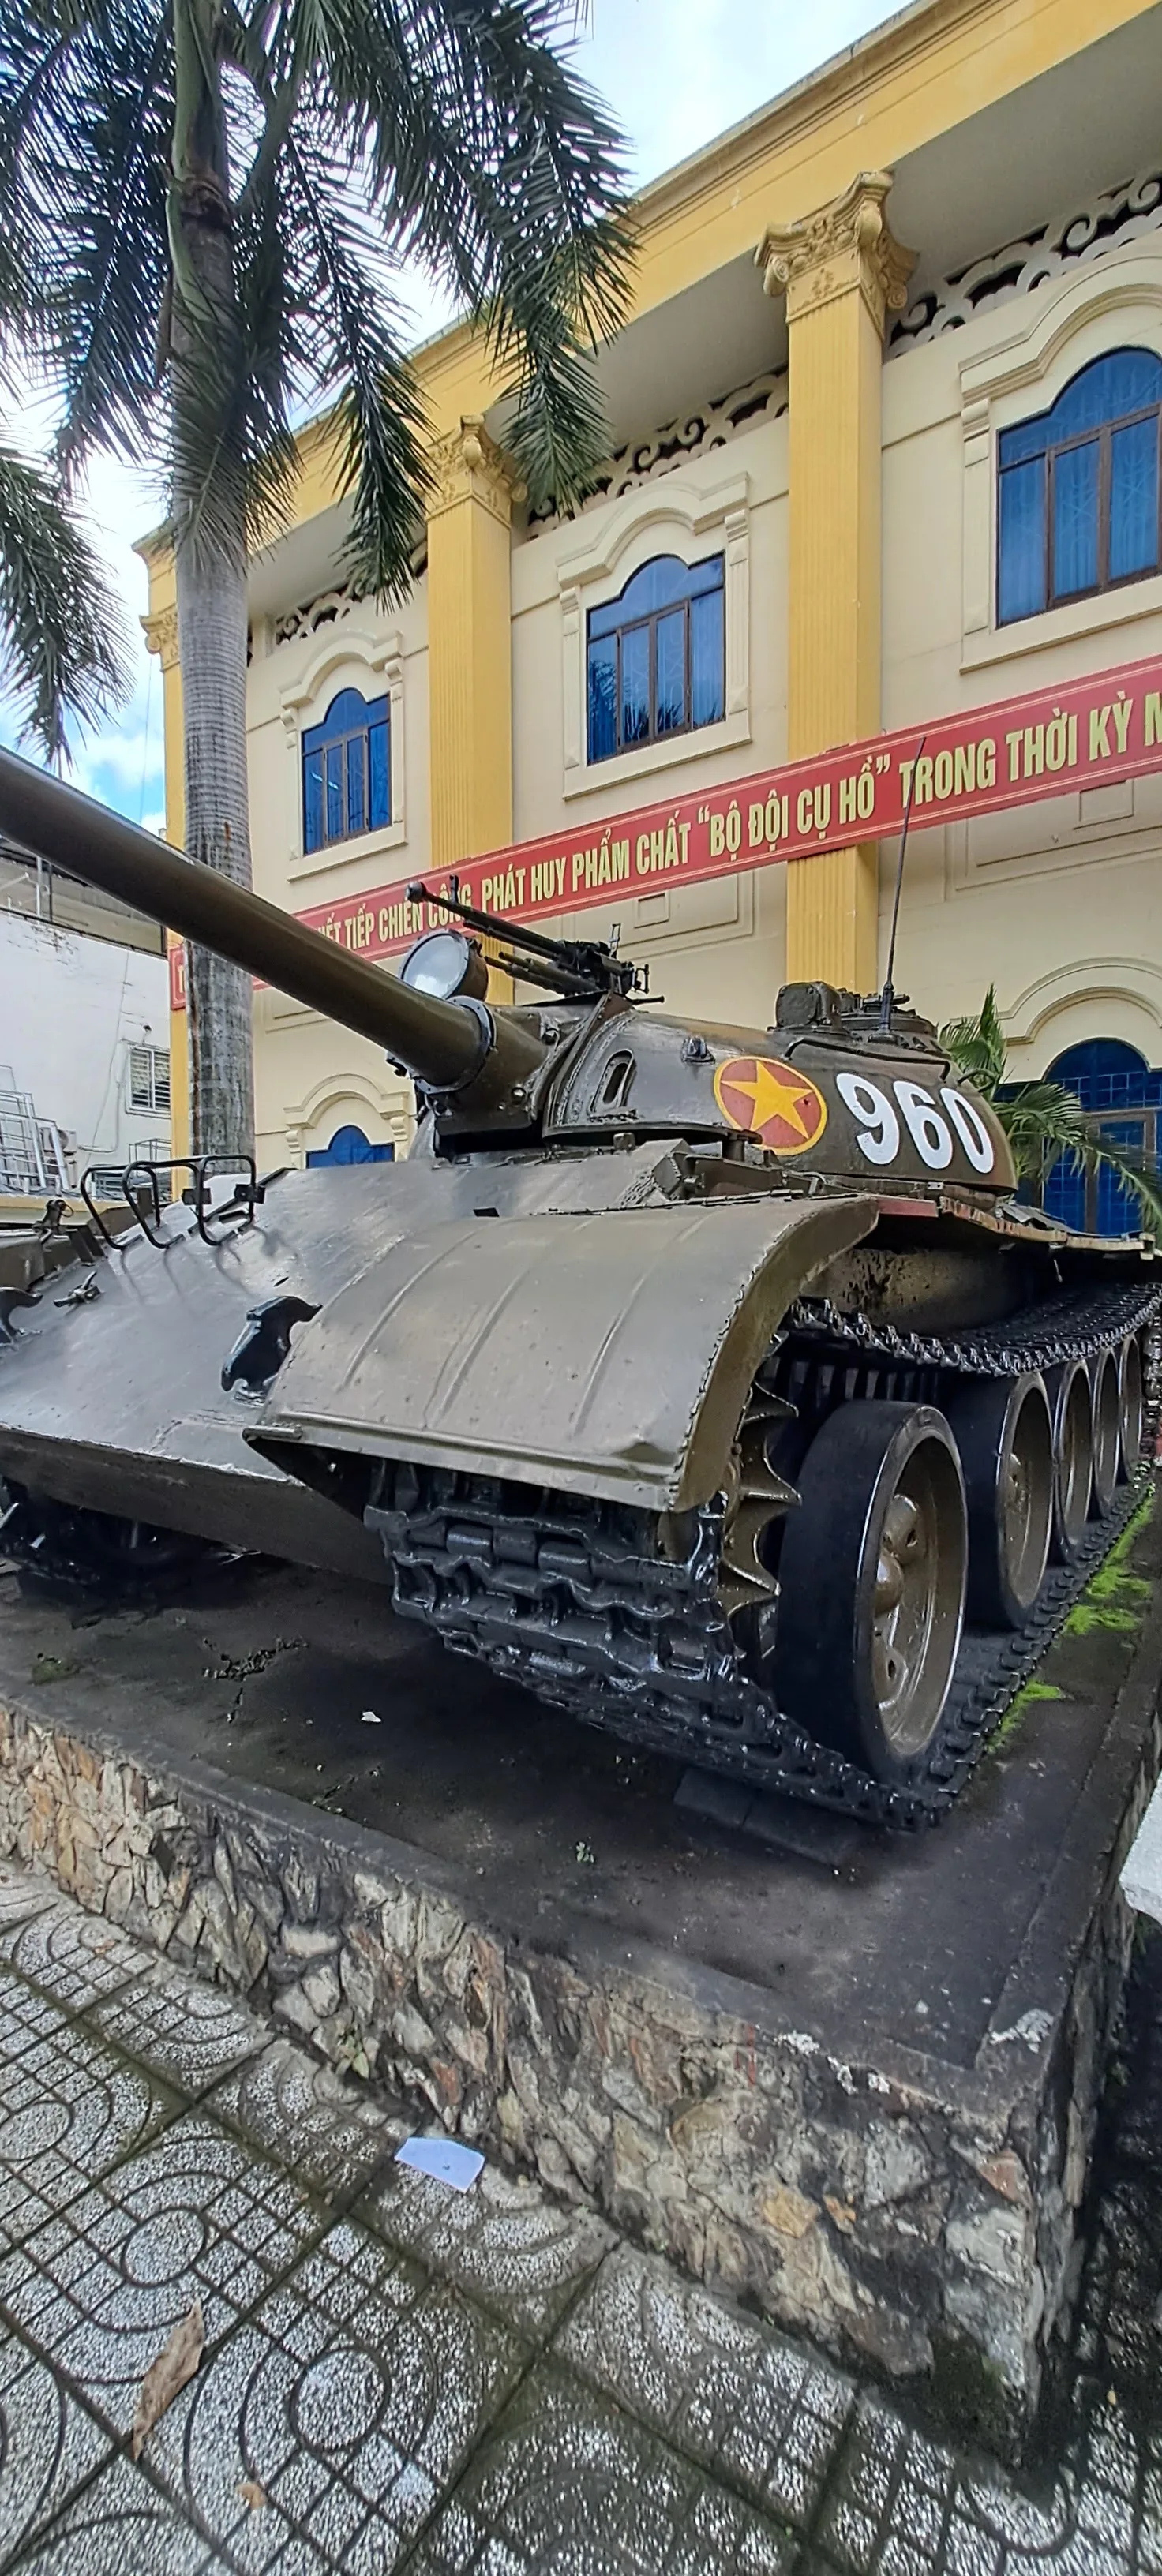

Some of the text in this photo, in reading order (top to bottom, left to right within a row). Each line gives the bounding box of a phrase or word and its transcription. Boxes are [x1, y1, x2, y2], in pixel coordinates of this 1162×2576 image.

[344, 903, 374, 950] TIẾP
[482, 863, 526, 913] PHÁT
[531, 856, 566, 902] HUY
[572, 828, 629, 892] PHẨM
[636, 810, 691, 875] CHẤT
[748, 789, 789, 852] ĐỘI
[797, 784, 831, 840] CỤ
[899, 739, 996, 808] TRONG
[1006, 707, 1078, 781] THỜI
[1089, 691, 1134, 762] KỲ
[836, 1073, 995, 1174] 960
